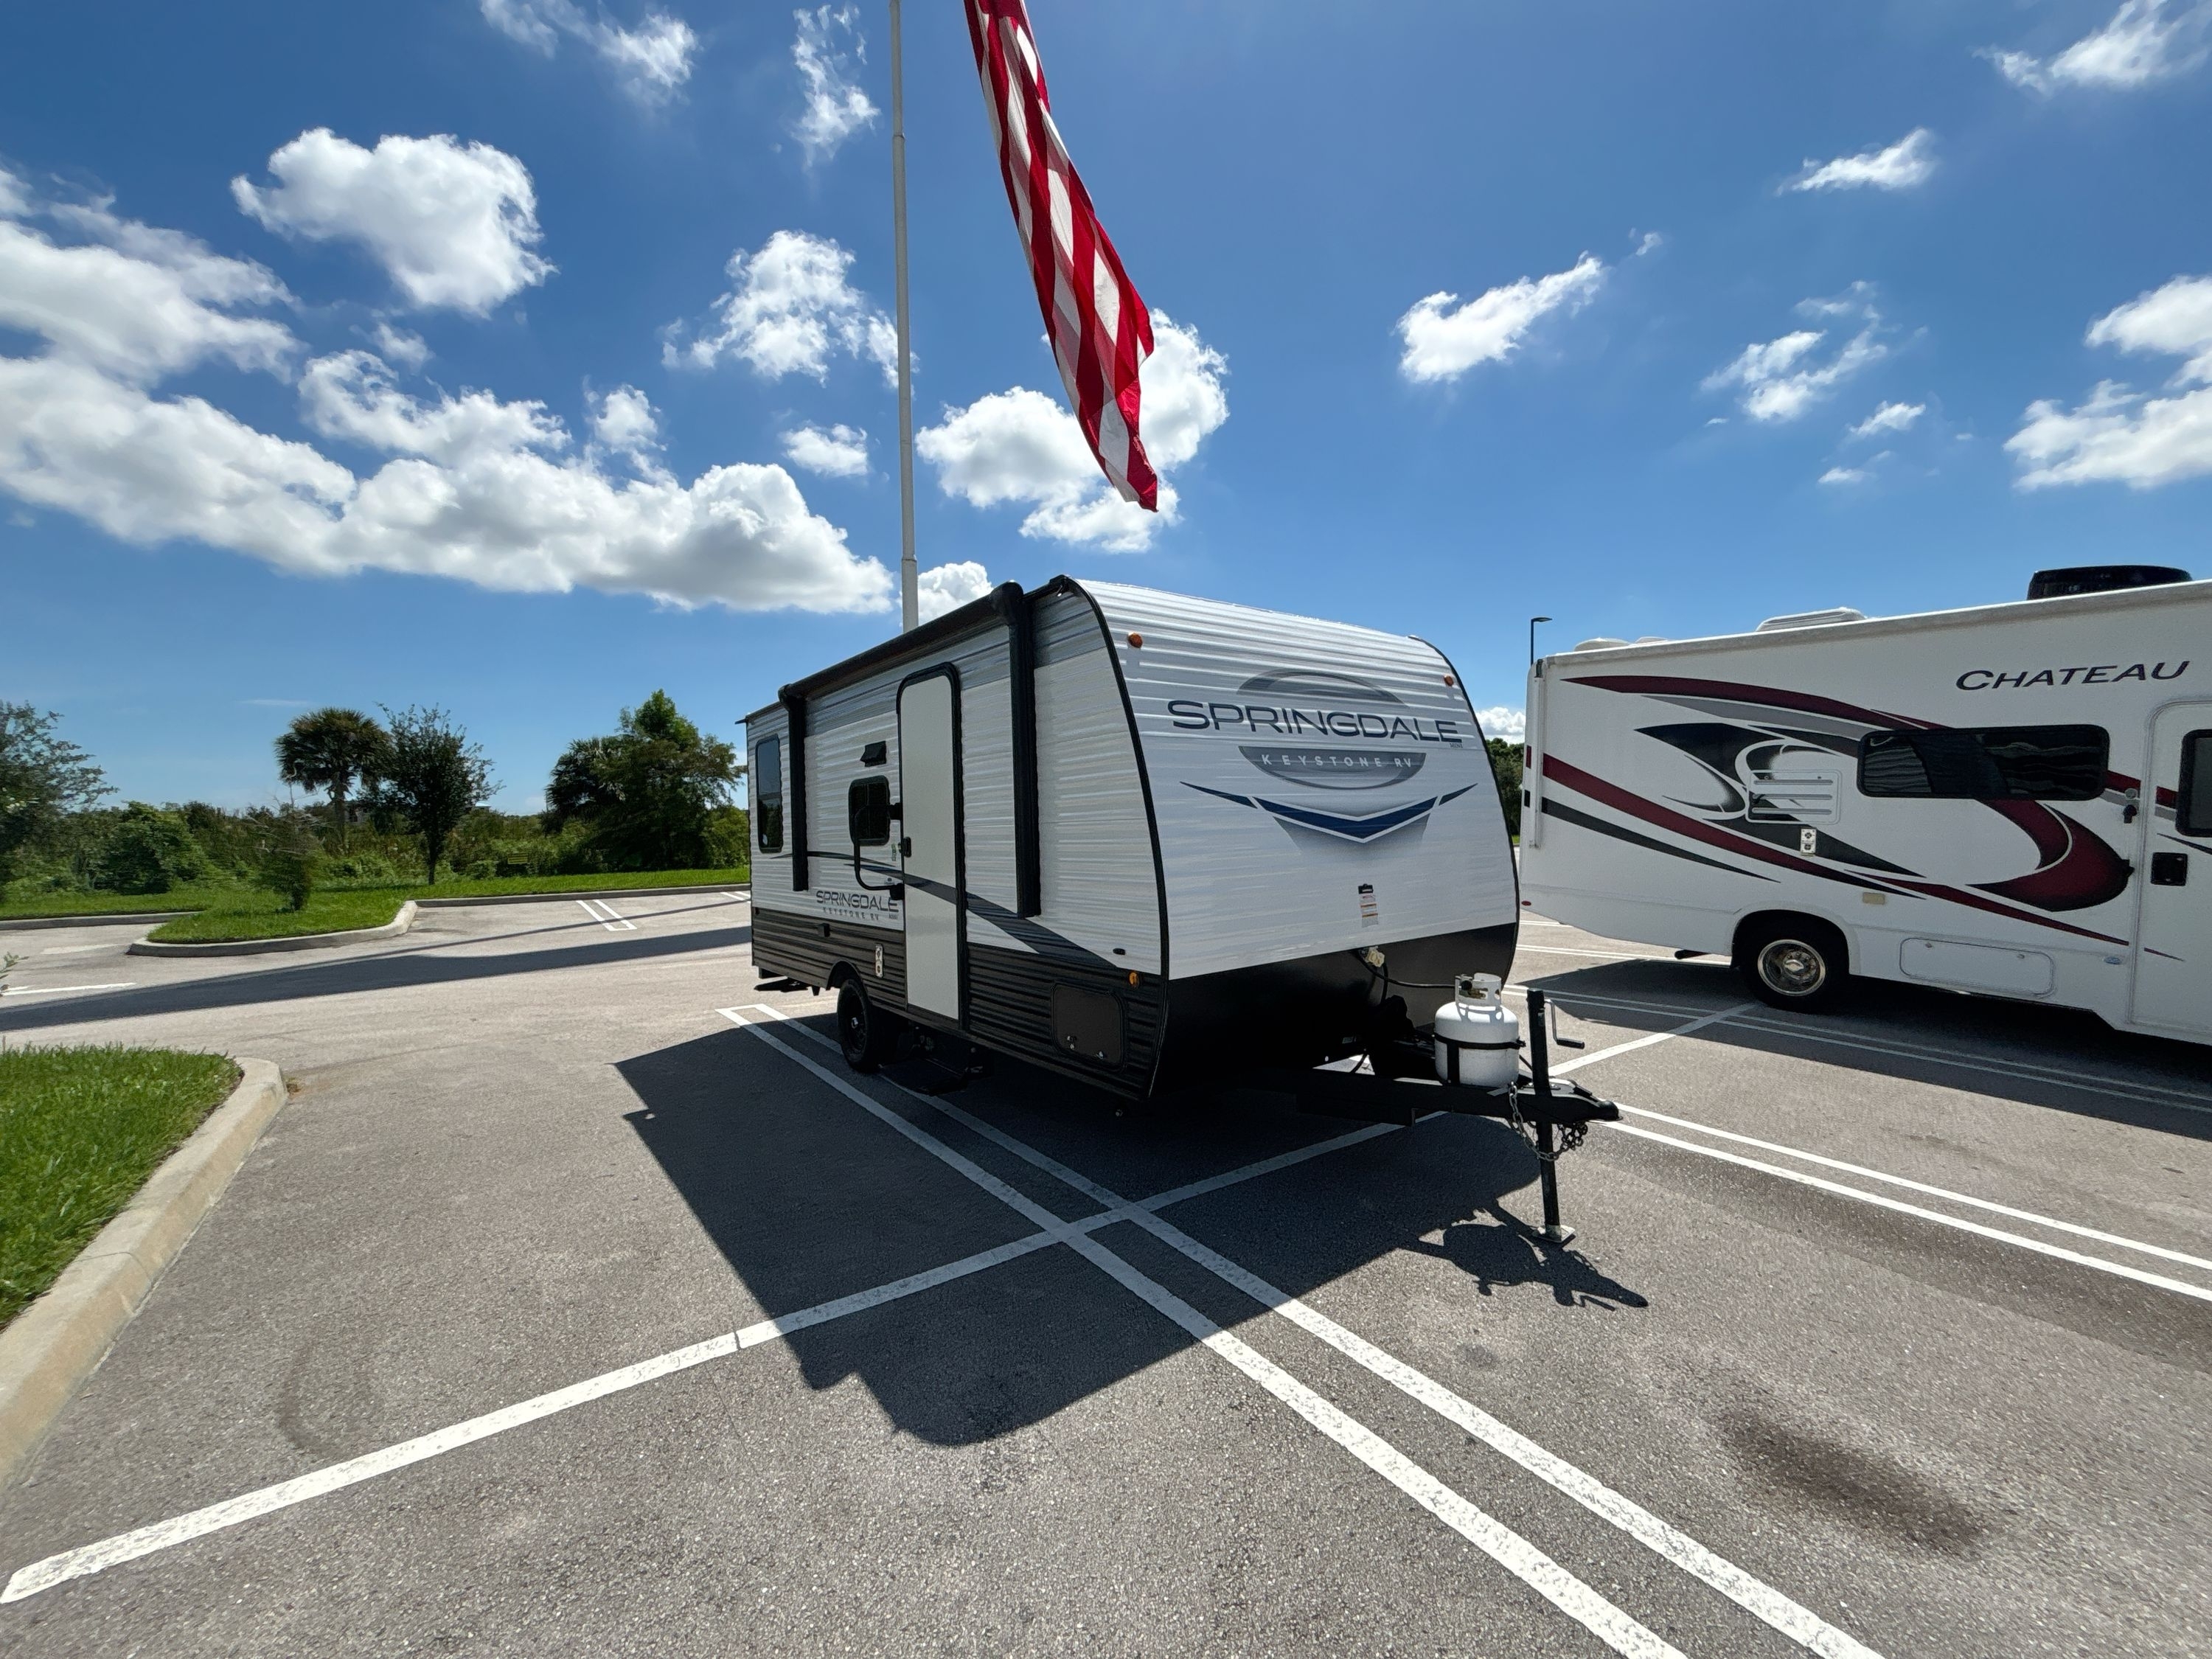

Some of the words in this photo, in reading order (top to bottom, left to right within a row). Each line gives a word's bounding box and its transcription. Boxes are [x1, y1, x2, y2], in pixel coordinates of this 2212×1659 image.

[1955, 661, 2190, 690] CHATEAU
[1167, 700, 1462, 743] SPRINGDALE
[1261, 754, 1382, 767] KEYSTONE
[1394, 757, 1412, 768] RV
[815, 890, 900, 913] SPRINGDALE
